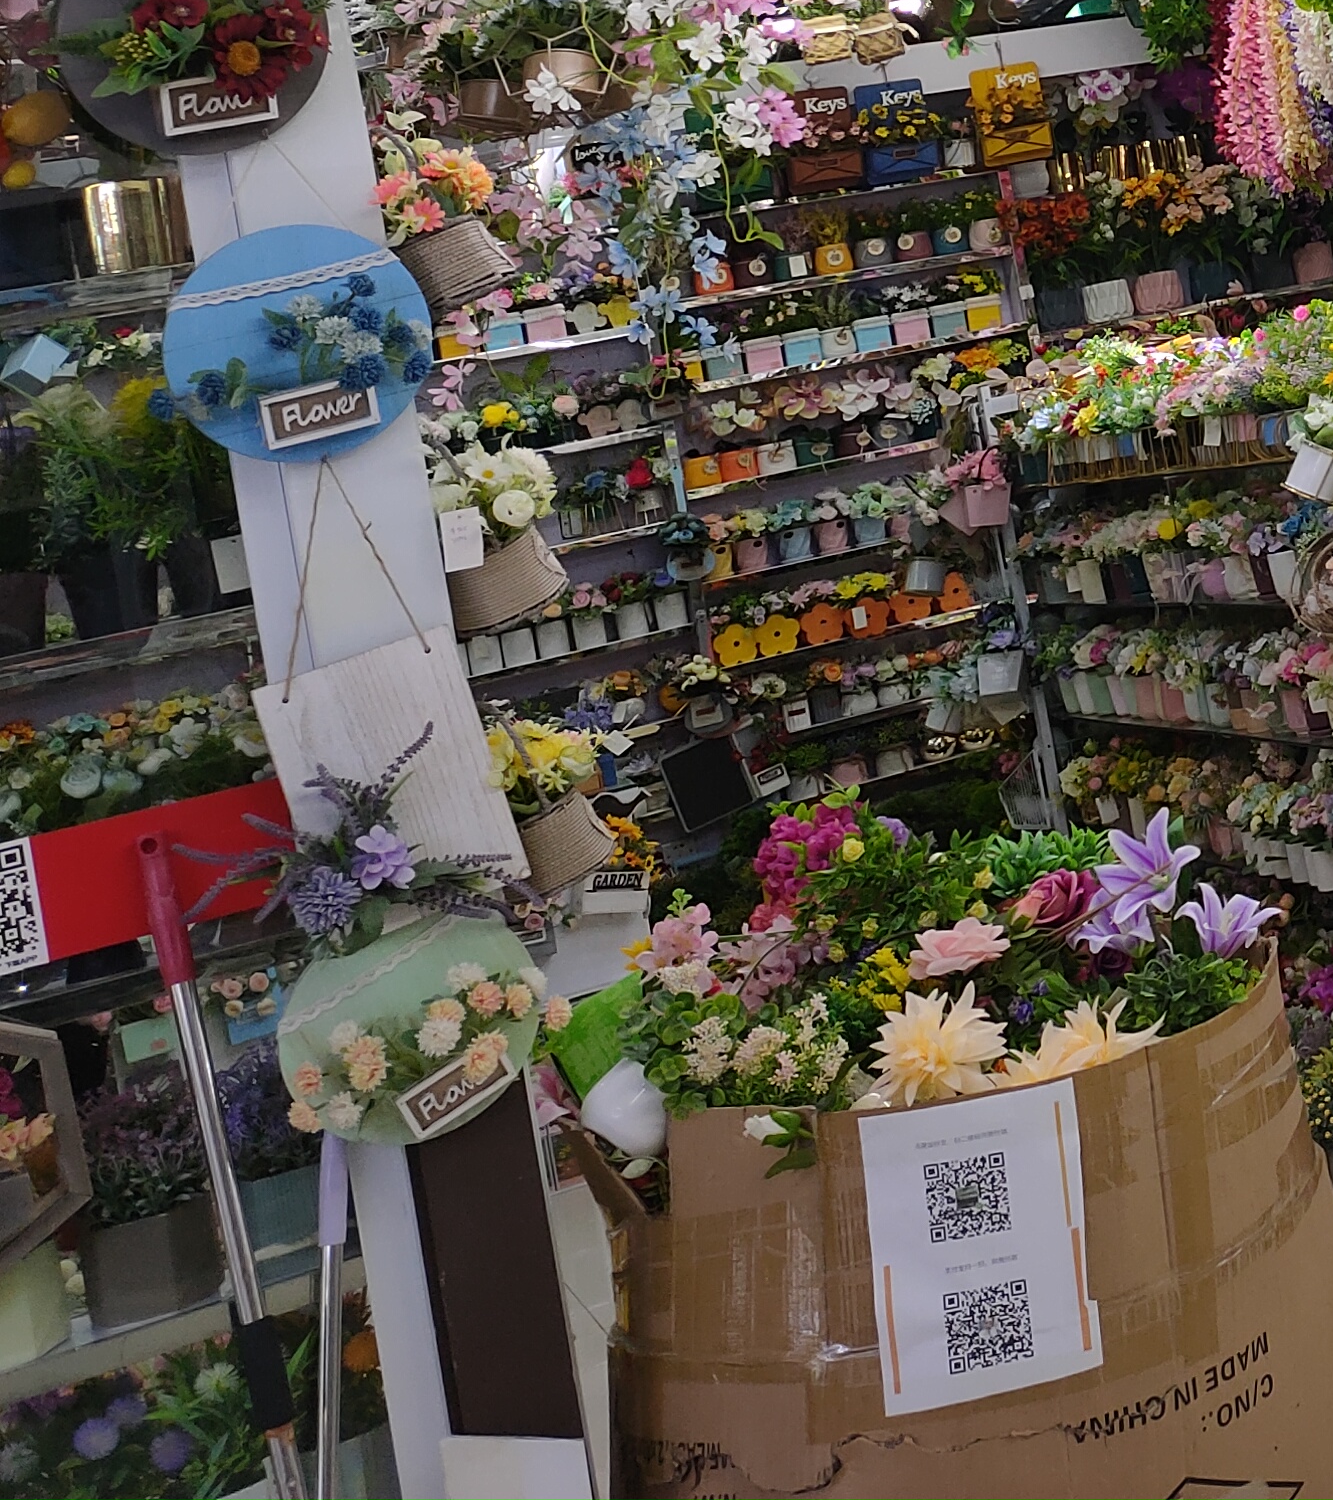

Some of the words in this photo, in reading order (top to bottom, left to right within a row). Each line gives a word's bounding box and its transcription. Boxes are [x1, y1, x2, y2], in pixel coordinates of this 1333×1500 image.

[804, 96, 848, 115] Keys
[281, 392, 362, 432] Flower
[593, 872, 645, 891] GARDEN
[1204, 1332, 1270, 1393] MADE
[1174, 1376, 1198, 1411] IN
[1064, 1396, 1166, 1444] CHINA
